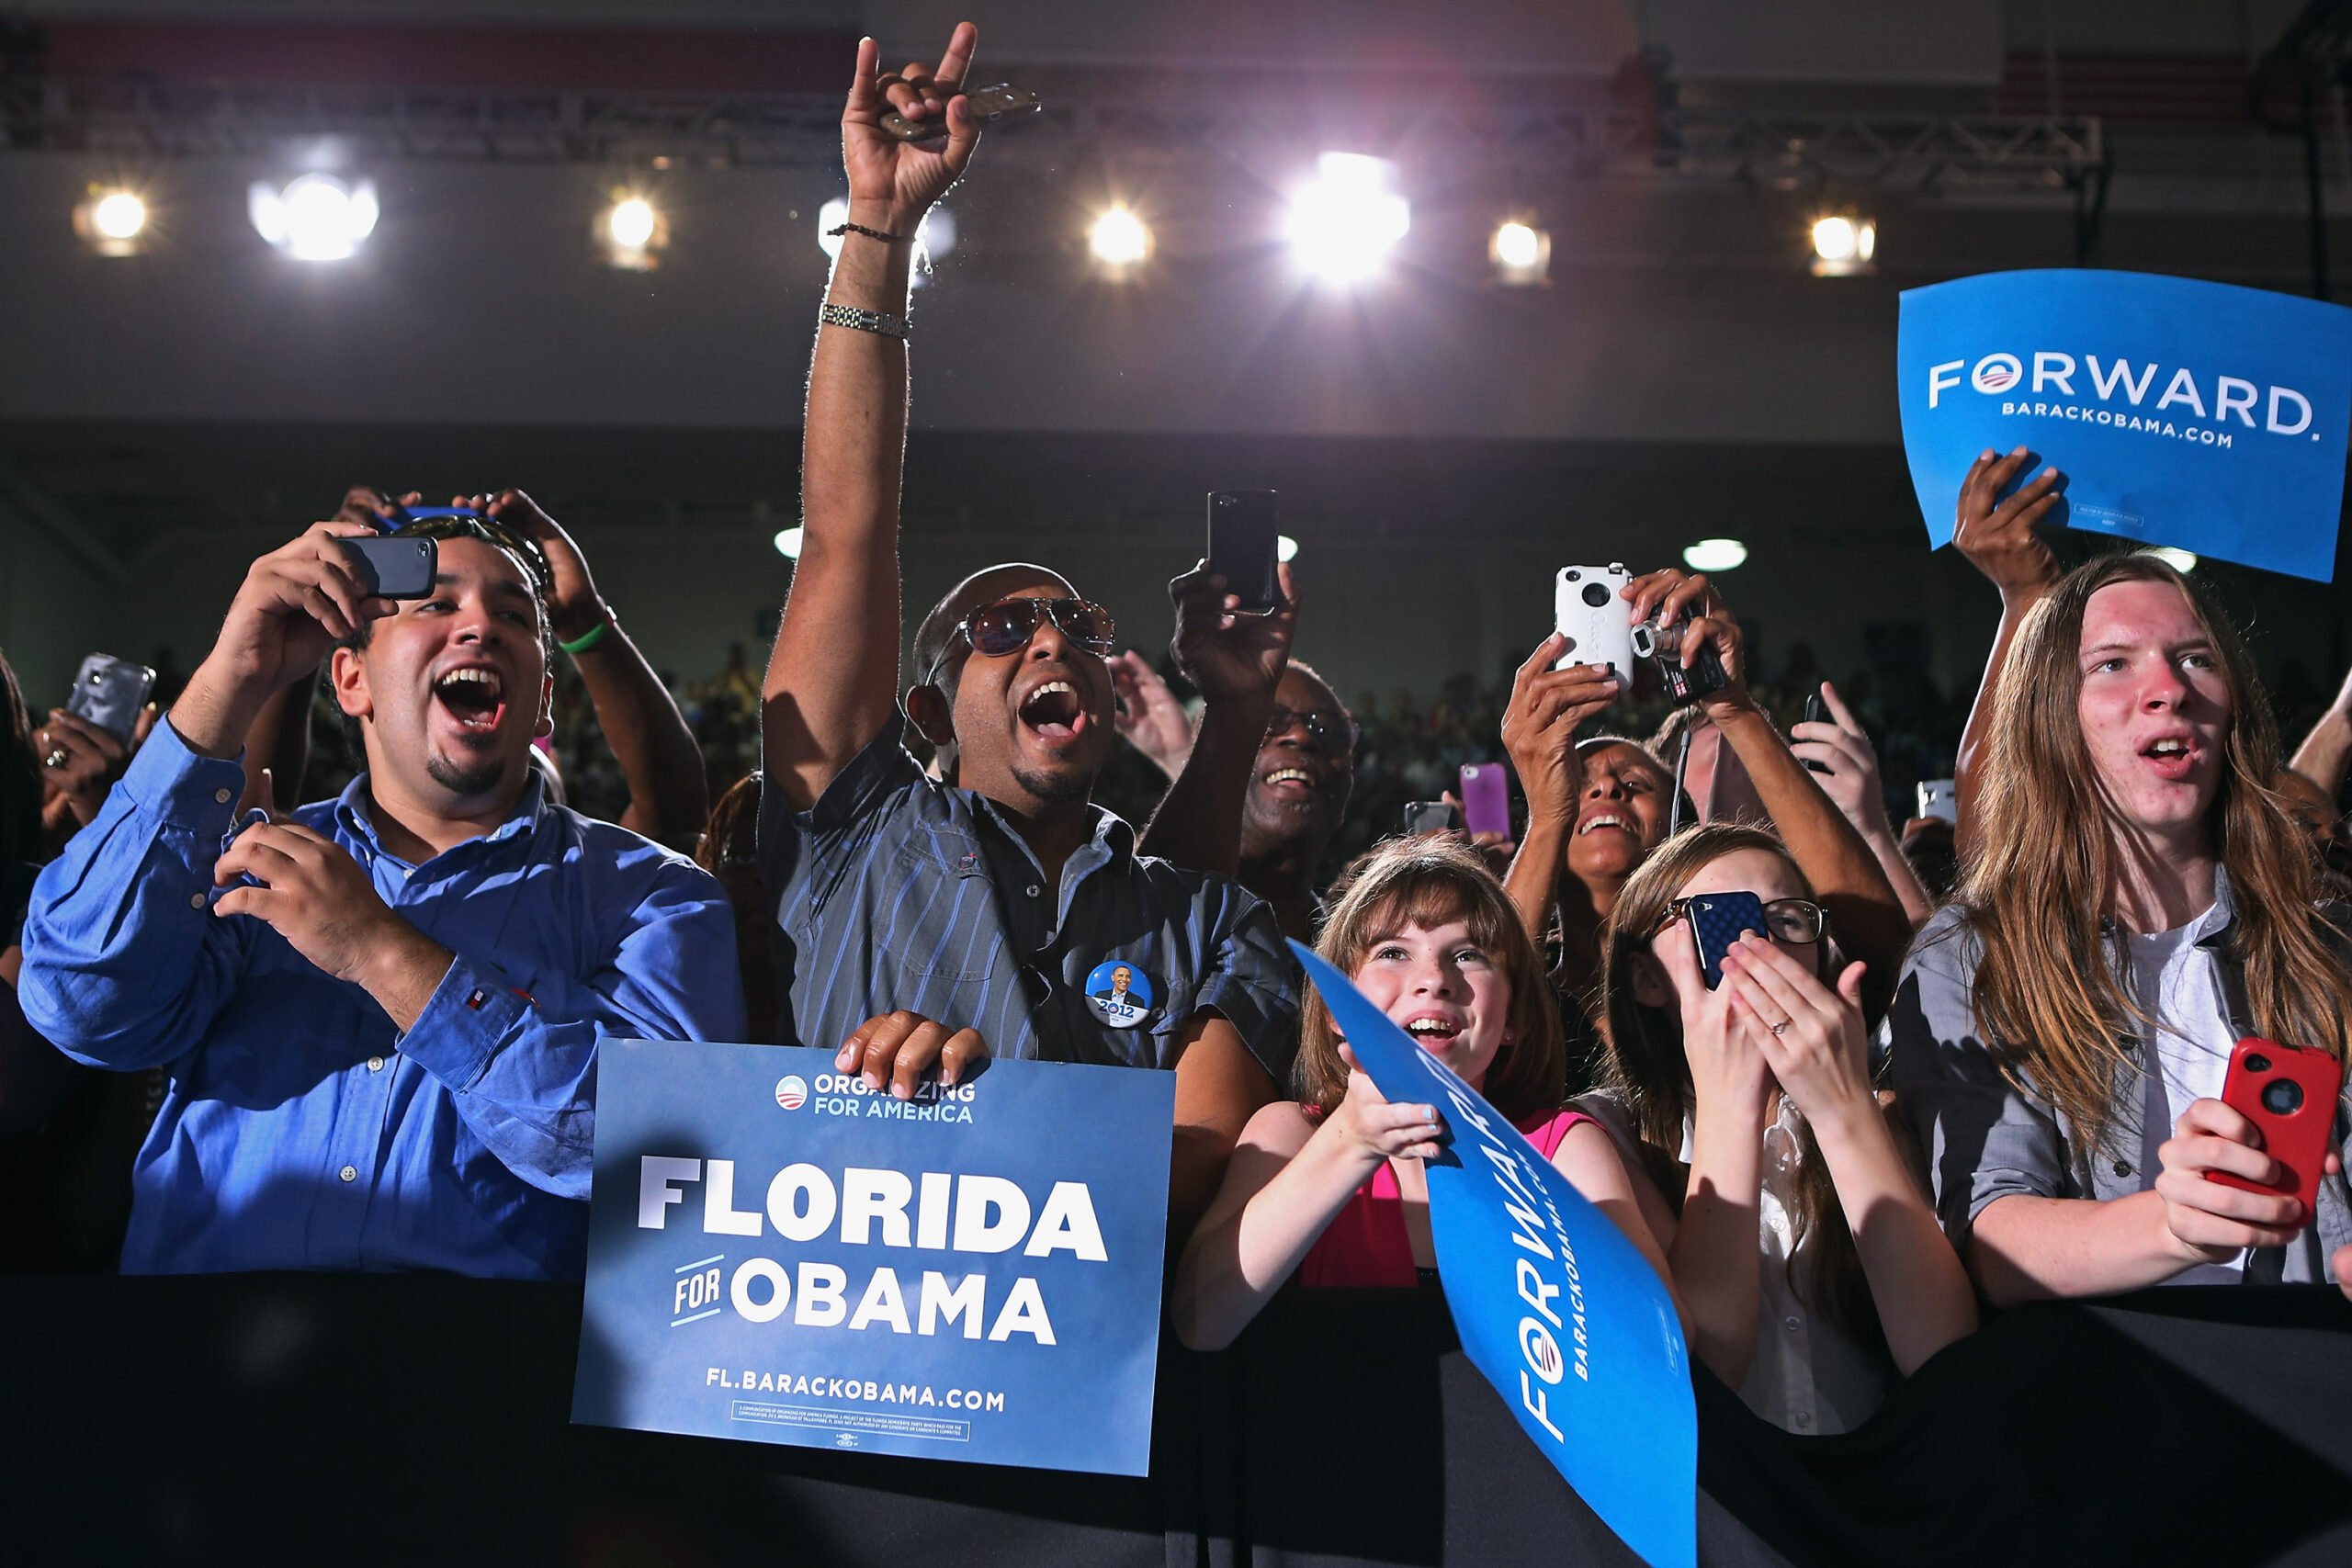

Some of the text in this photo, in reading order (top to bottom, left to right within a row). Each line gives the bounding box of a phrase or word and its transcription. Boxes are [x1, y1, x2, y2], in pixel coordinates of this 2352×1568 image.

[1928, 350, 2321, 443] FORWARD.
[2002, 401, 2233, 449] BARACKOBAMA.COM
[1099, 1000, 1135, 1019] 2012
[814, 1097, 974, 1124] FOR AMERICA
[638, 1156, 1108, 1262] FLORIDA
[673, 1258, 1057, 1346] FOR OBAMA
[706, 1367, 1005, 1413] FL.BARACKOBAMA.COM
